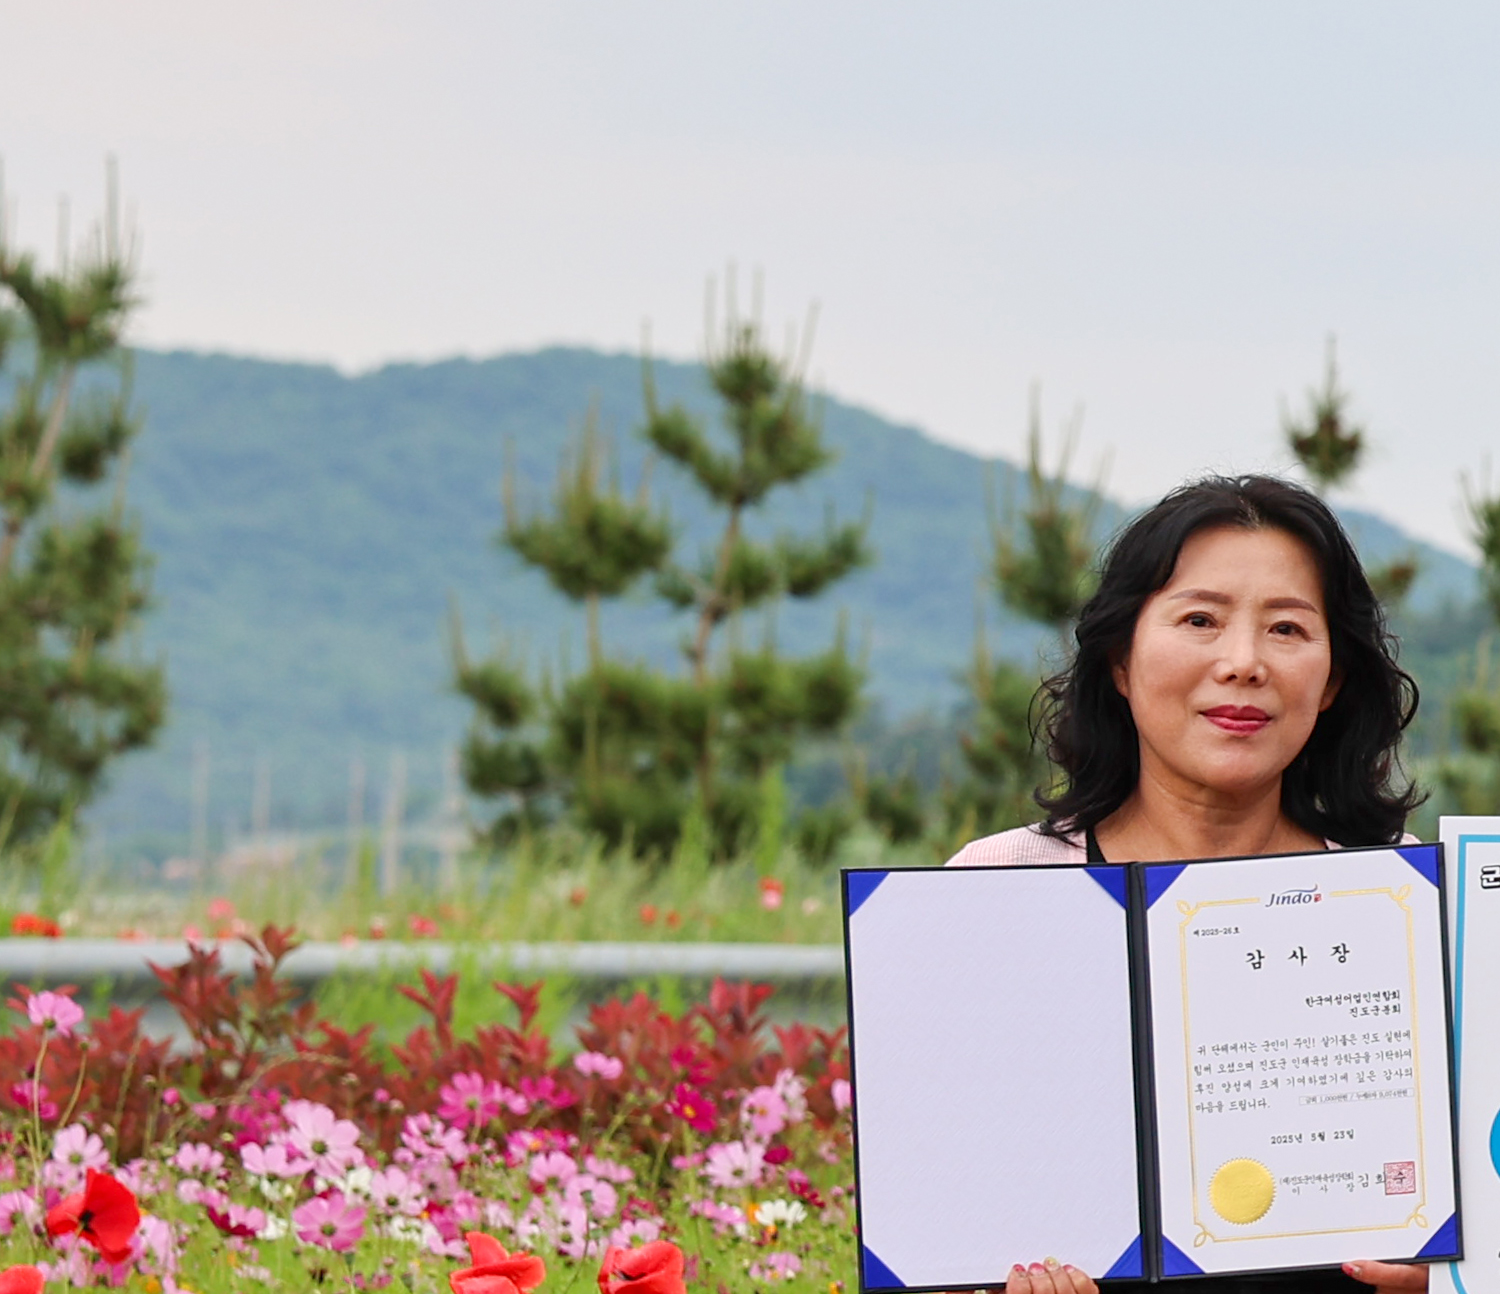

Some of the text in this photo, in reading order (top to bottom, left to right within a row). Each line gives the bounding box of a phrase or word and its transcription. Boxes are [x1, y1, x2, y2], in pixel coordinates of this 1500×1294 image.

[1265, 891, 1312, 907] Jindo
[1305, 990, 1400, 1008] 한국여성어업인연합회
[1349, 1004, 1401, 1018] 진도군분회
[1362, 1032, 1380, 1043] 진도
[1260, 1059, 1287, 1071] 진도군
[1292, 1055, 1328, 1068] 인재육성
[1334, 1053, 1371, 1065] 장학금을
[1196, 1101, 1223, 1113] 마음을
[1271, 1129, 1354, 1144] 2025년 5월 23일
